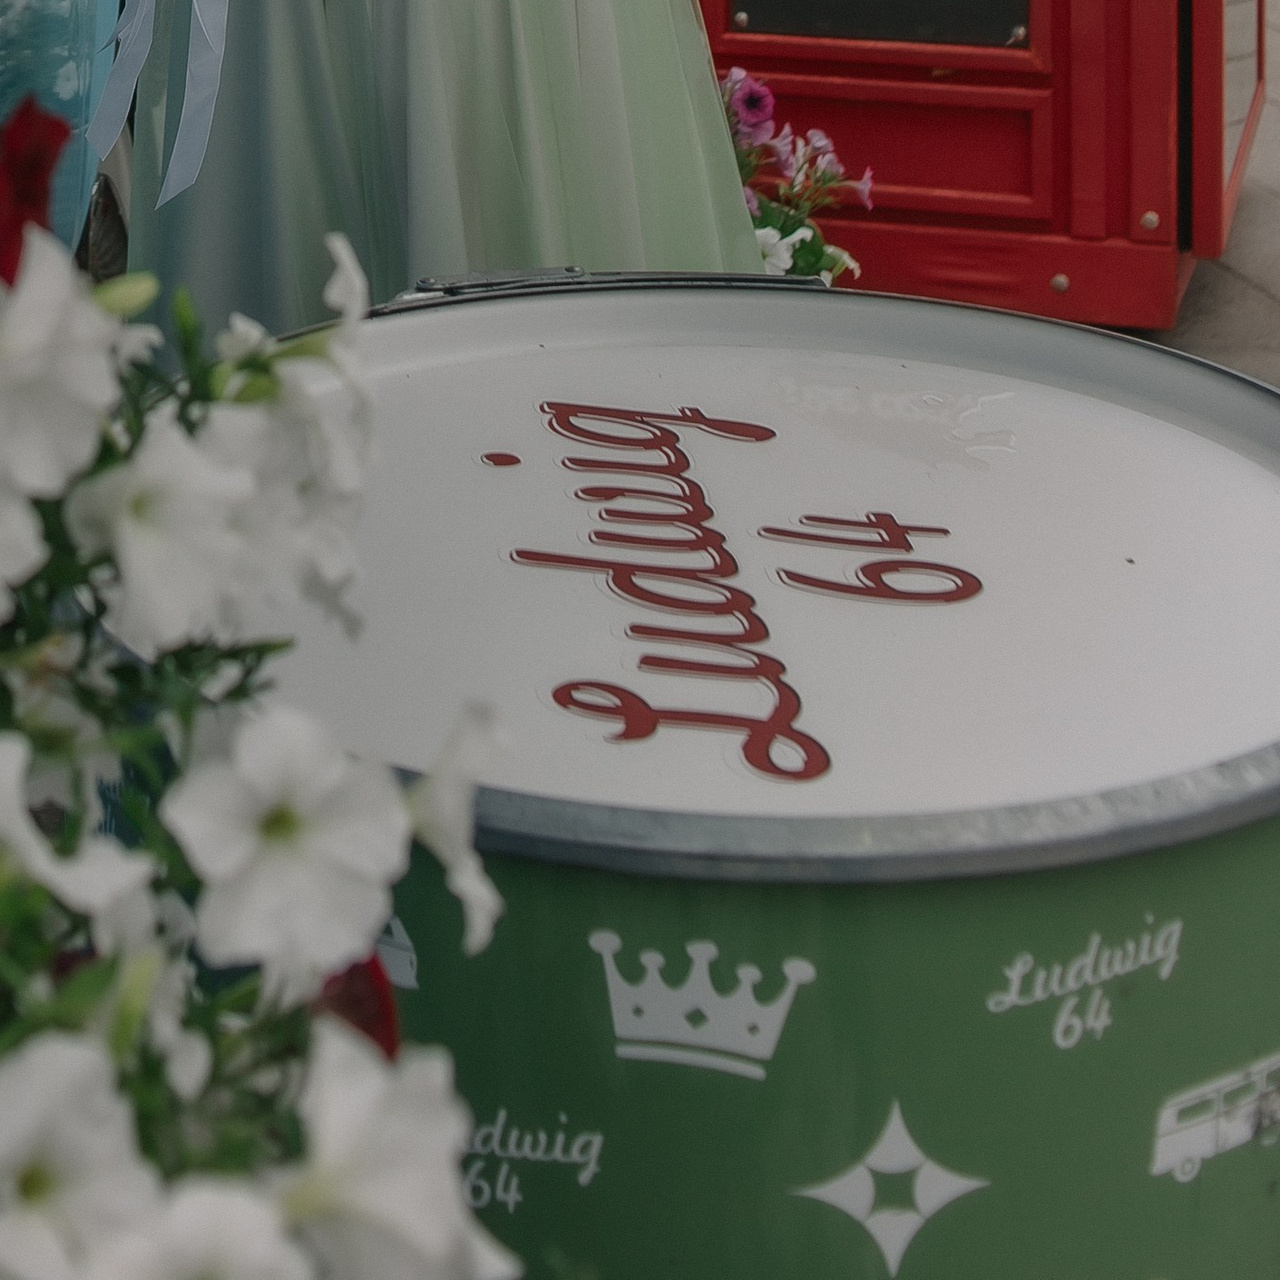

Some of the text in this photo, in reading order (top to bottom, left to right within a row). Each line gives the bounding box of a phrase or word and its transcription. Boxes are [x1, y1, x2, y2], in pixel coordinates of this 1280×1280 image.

[481, 400, 832, 782] Ludwig
[757, 511, 985, 606] 64
[985, 911, 1183, 1013] Ludwig
[1052, 987, 1113, 1050] 64
[465, 1159, 524, 1215] 64
[470, 1108, 604, 1187] dwig
